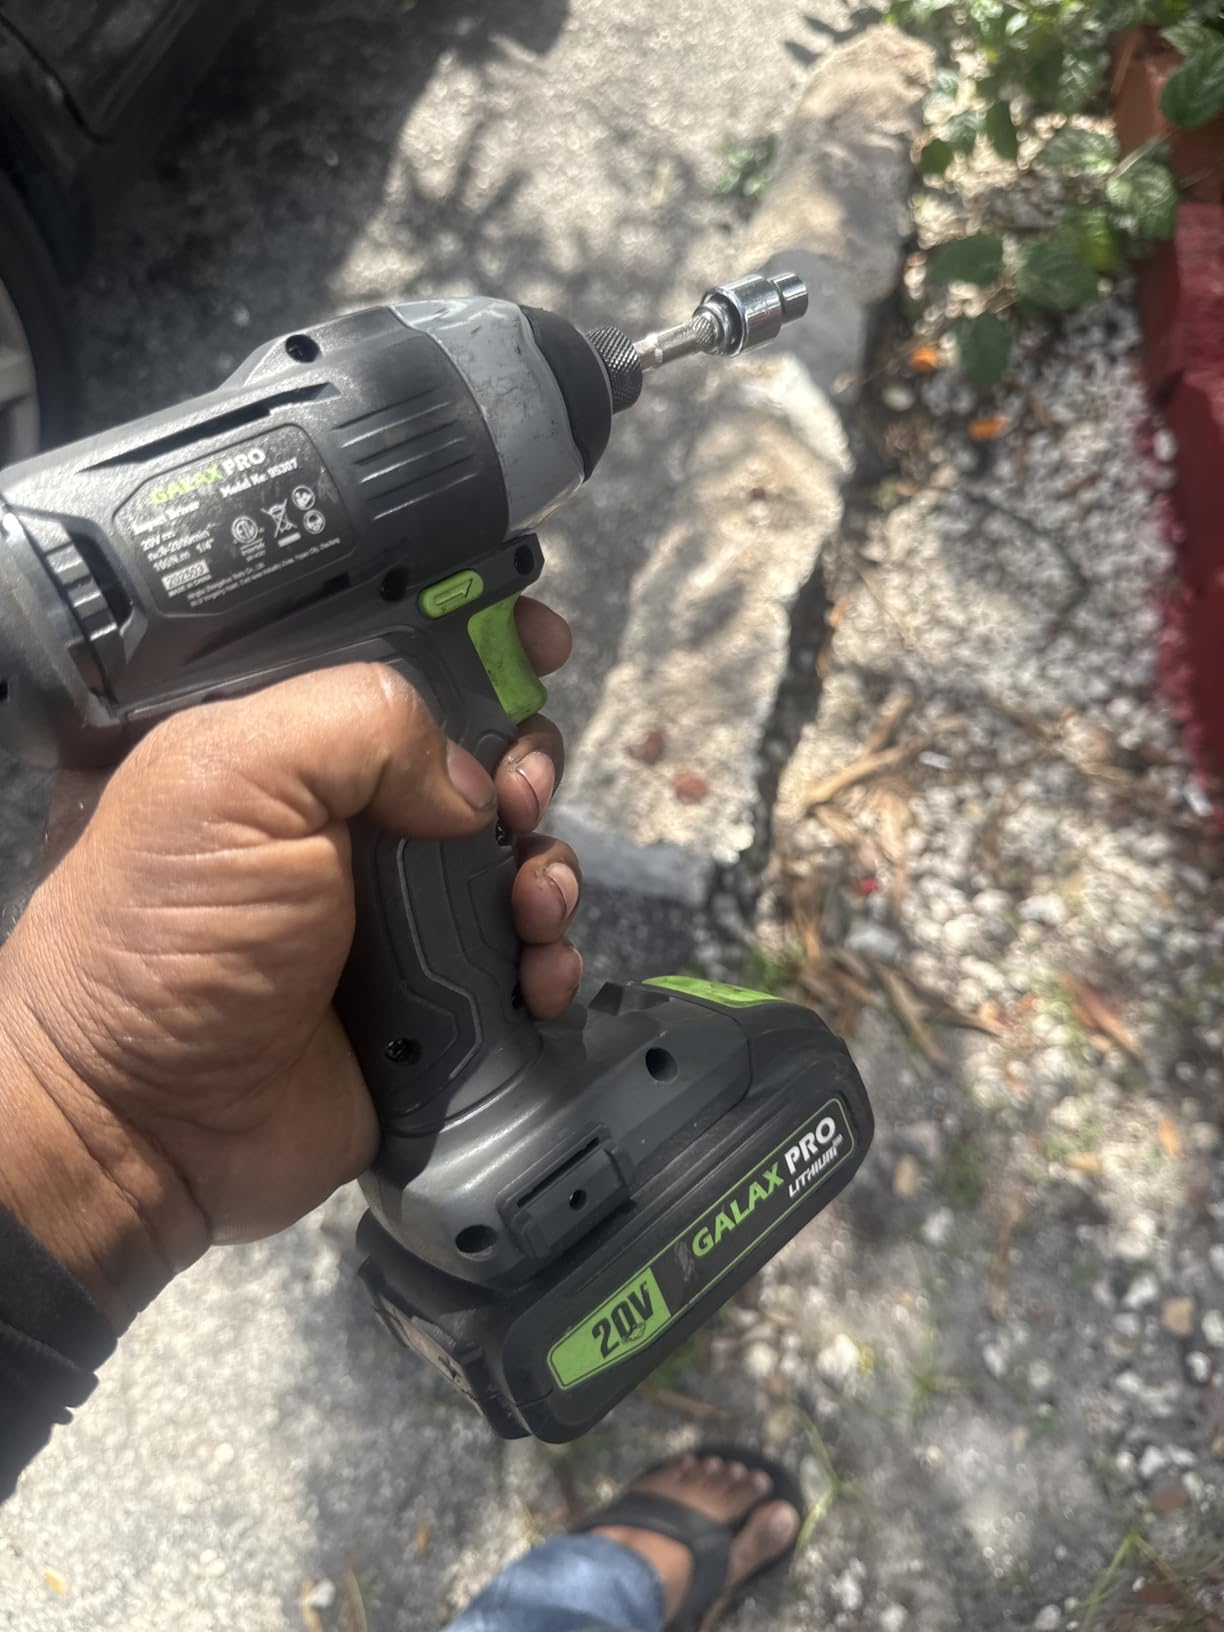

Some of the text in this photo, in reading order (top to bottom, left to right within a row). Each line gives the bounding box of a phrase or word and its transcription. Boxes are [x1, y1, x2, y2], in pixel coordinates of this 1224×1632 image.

[151, 448, 265, 504] GALAX PRO
[692, 1116, 836, 1257] GALAX PRO
[788, 1146, 839, 1198] LITHIUM
[591, 1280, 654, 1359] 20V
